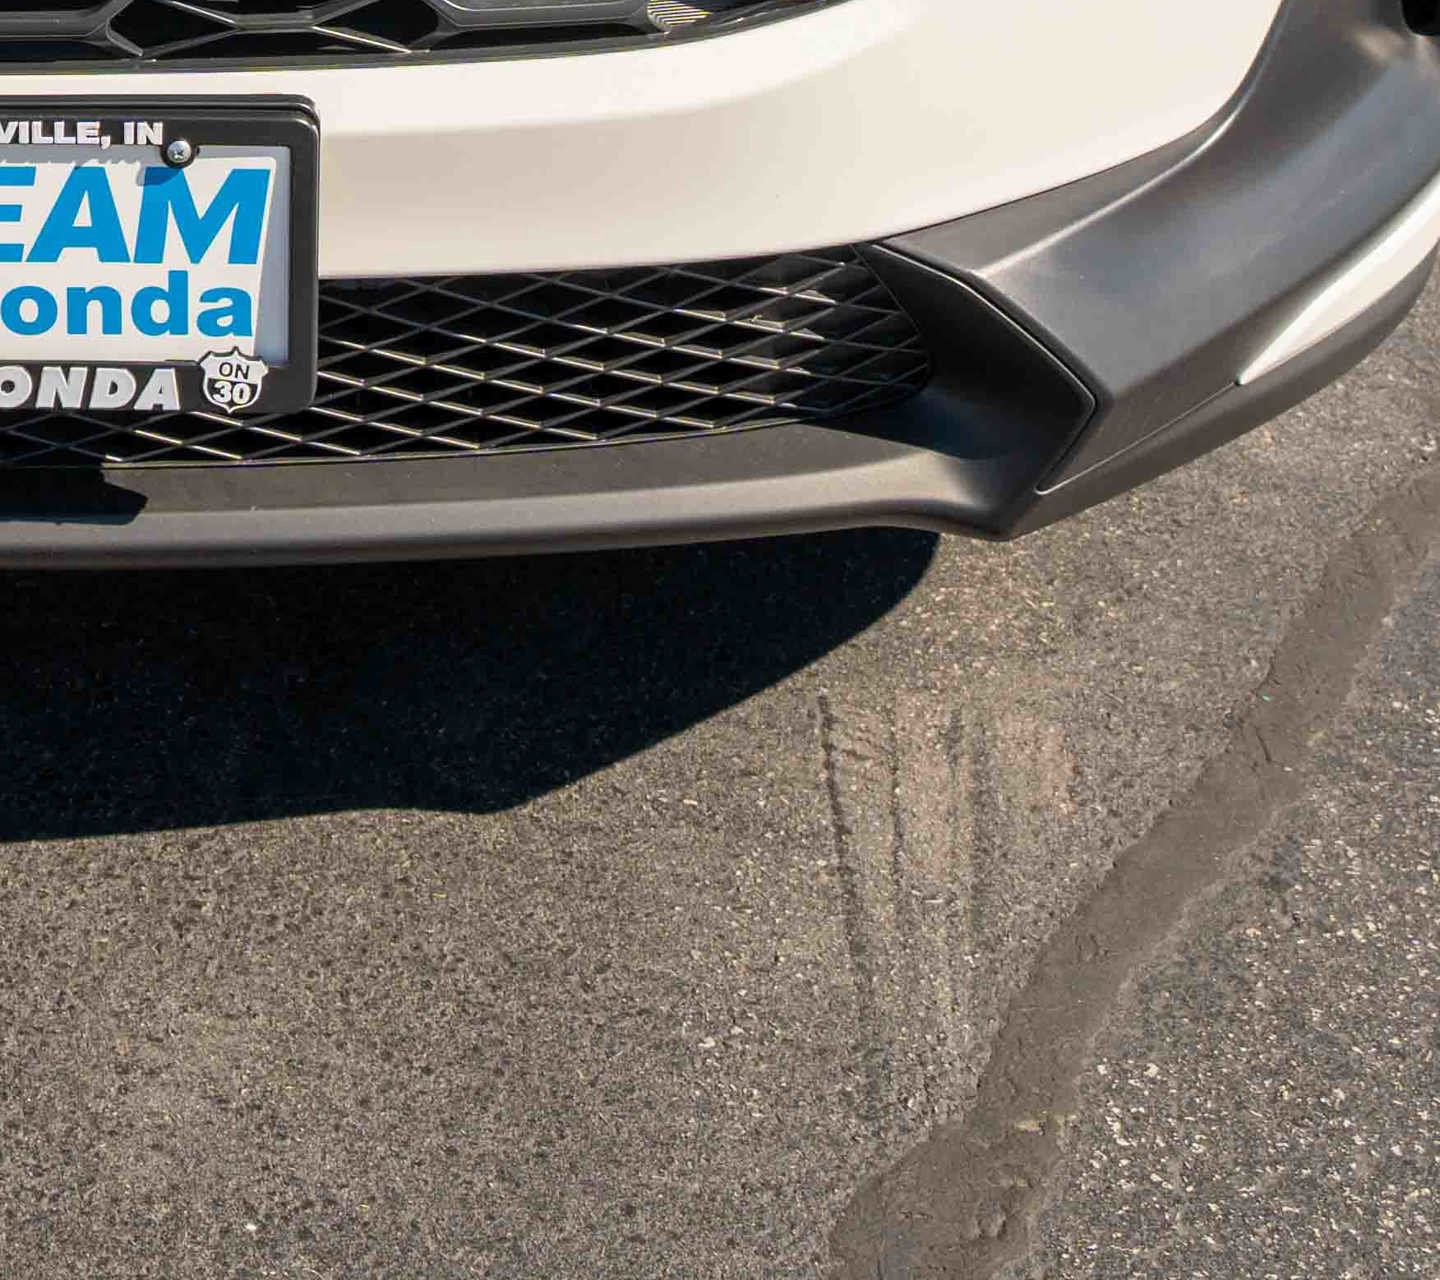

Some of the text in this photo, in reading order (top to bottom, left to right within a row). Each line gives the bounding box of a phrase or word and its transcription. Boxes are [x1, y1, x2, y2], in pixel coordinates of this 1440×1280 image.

[124, 121, 164, 145] IN
[218, 361, 250, 380] ON
[212, 380, 252, 405] 30
